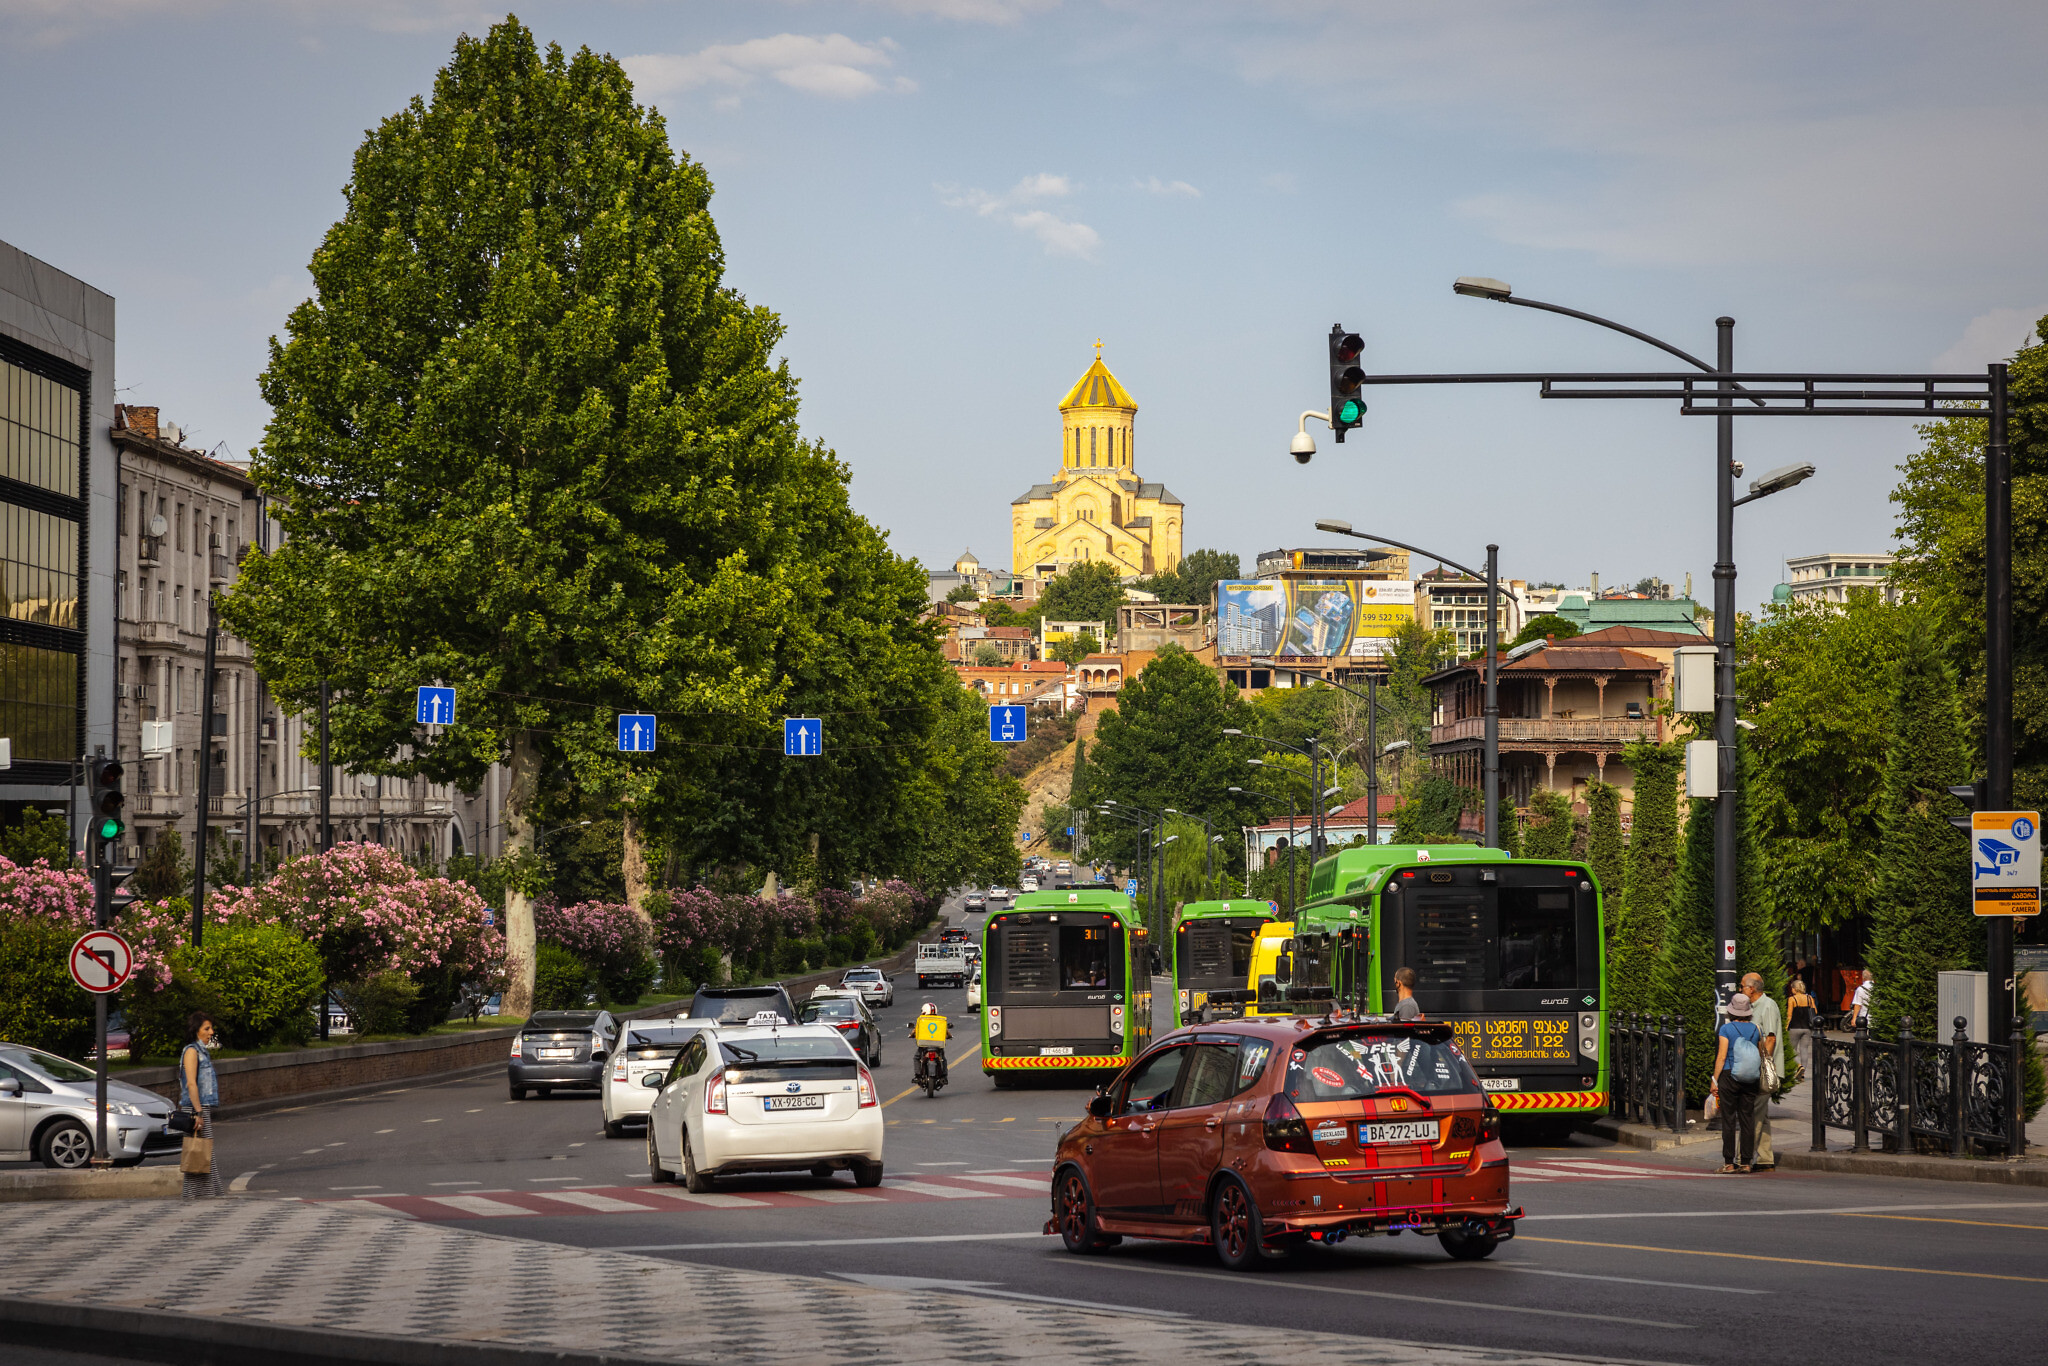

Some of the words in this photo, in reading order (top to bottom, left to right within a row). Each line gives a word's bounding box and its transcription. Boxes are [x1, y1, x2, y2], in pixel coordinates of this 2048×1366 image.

[1454, 1021, 1480, 1034] ბინა
[1486, 1020, 1528, 1034] საშენო
[1533, 1020, 1569, 1034] ფასად
[1370, 1042, 1396, 1053] Fit
[1472, 1036, 1482, 1048] 2
[1492, 1036, 1522, 1048] 622
[1534, 1036, 1564, 1047] 122
[1336, 1044, 1354, 1061] USA
[1407, 1045, 1421, 1076] GEORGIA
[772, 1097, 816, 1107] XX-928-CC
[1370, 1124, 1430, 1140] BA-272-LU
